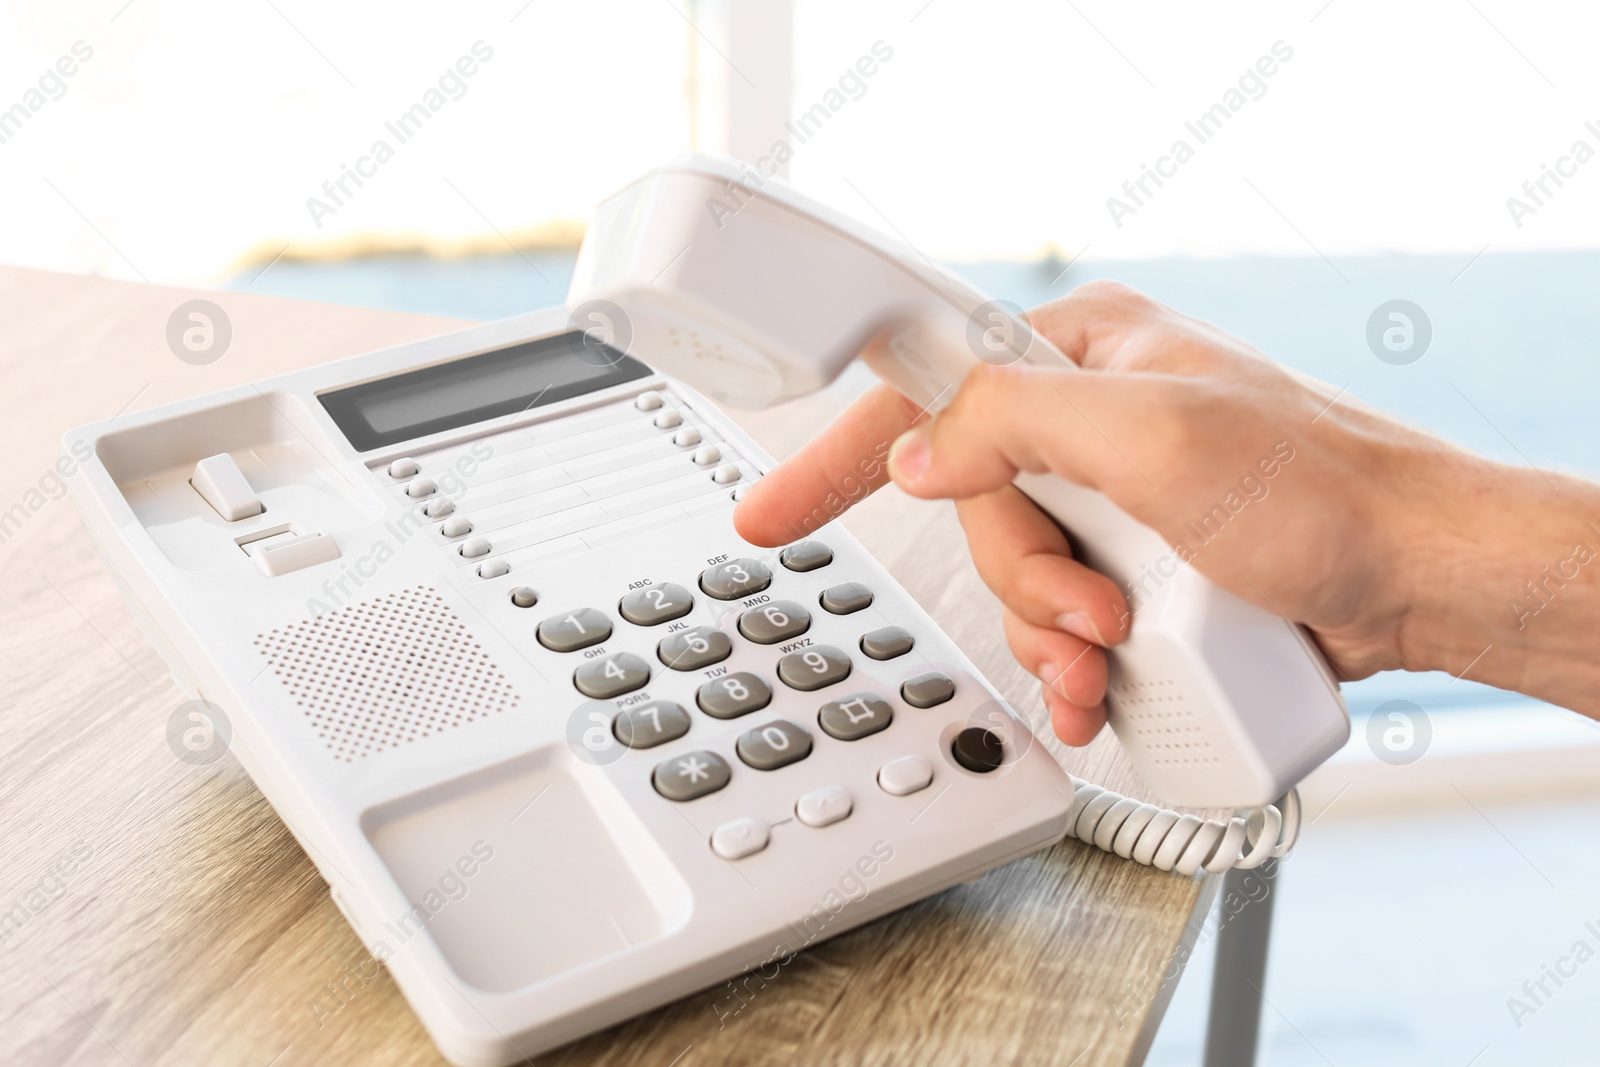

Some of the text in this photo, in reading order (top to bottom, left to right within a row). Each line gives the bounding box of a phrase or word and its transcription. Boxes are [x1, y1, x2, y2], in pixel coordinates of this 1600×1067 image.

[707, 554, 729, 566] DEF
[725, 564, 750, 583] 3
[628, 578, 653, 591] ABC
[645, 589, 673, 610] 2
[743, 594, 771, 608] MNO
[564, 614, 586, 634] 1
[763, 606, 789, 627] 6
[667, 621, 690, 633] JKL
[683, 631, 710, 653] 5
[779, 637, 814, 654] WXYZ
[583, 647, 607, 659] GHI
[802, 651, 829, 673] 9
[604, 659, 626, 680] 4
[703, 666, 728, 679] TUV
[722, 678, 749, 700] 8
[616, 692, 651, 707] PQRS
[639, 706, 662, 733] 7
